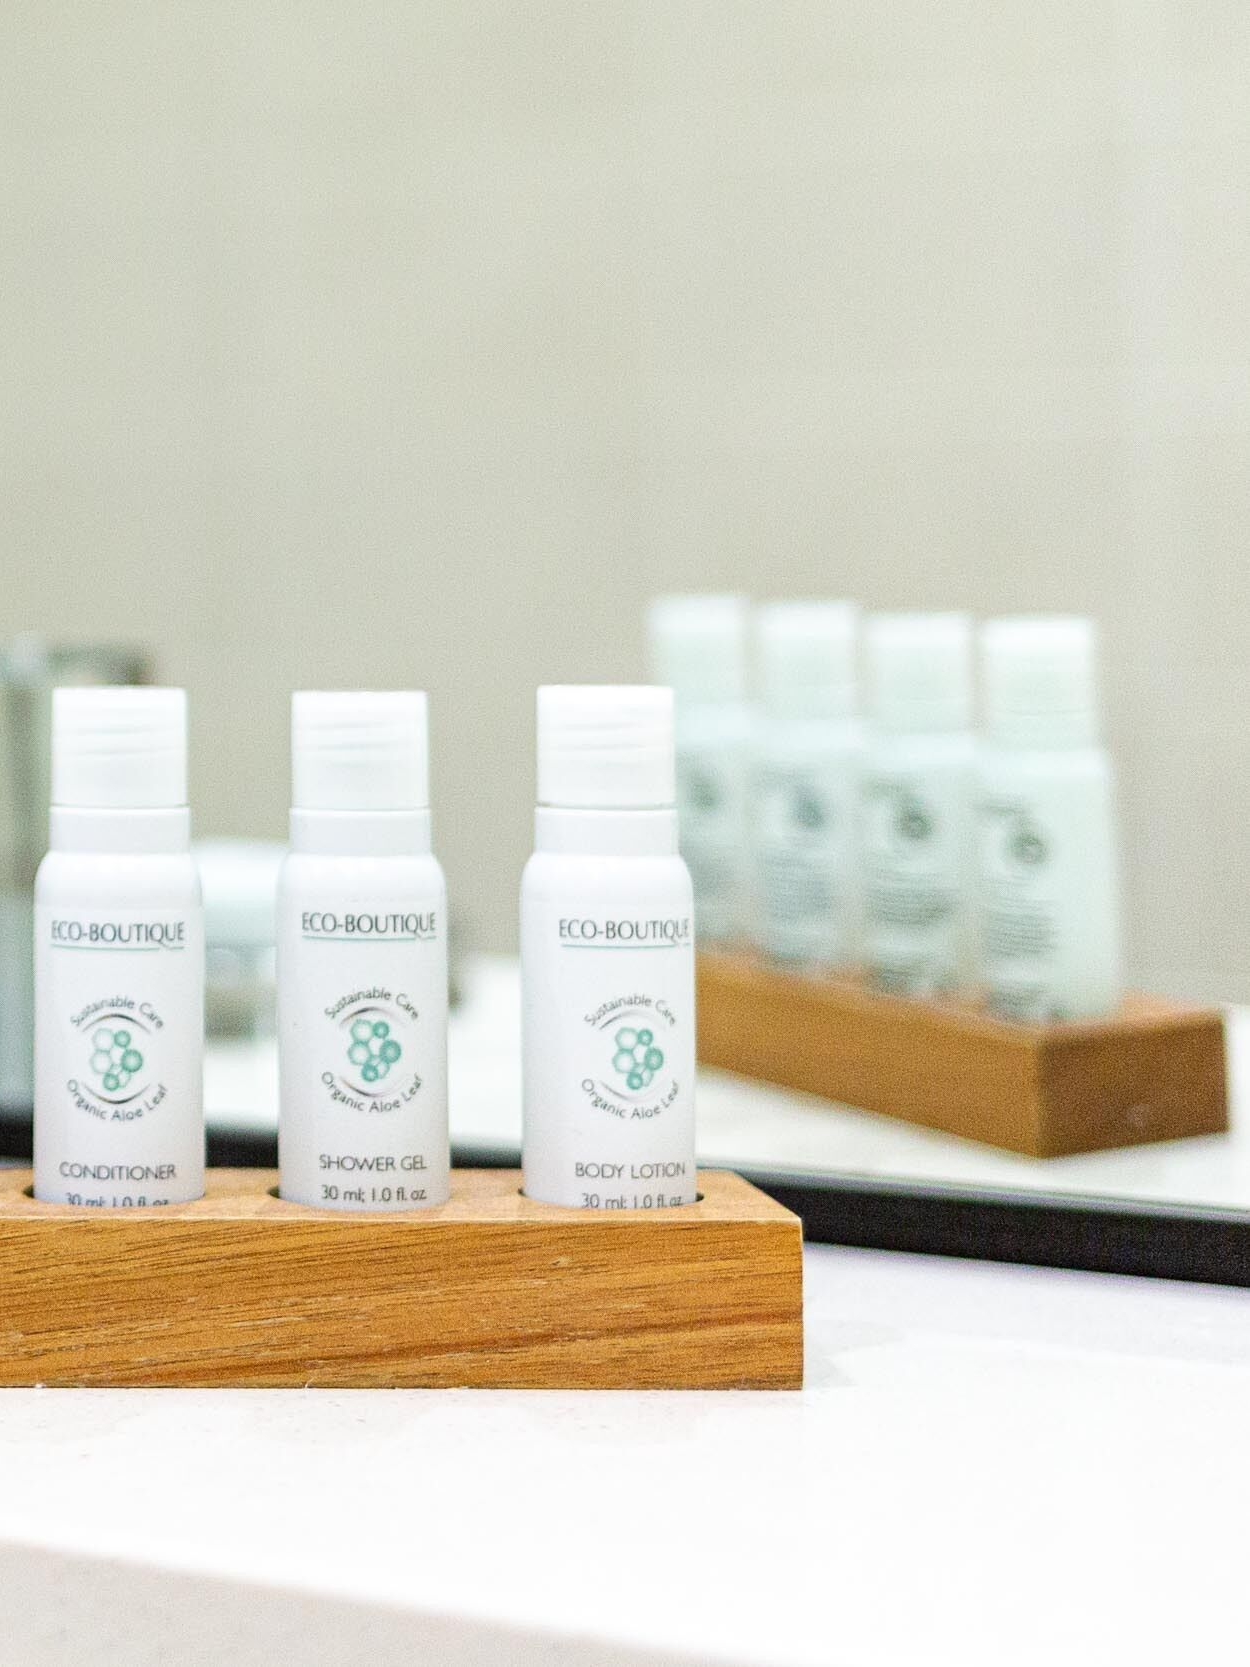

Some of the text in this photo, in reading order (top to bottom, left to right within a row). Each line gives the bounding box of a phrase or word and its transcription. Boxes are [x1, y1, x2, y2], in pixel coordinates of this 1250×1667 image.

[51, 920, 185, 949] ECO-BOUTIQUE
[302, 912, 436, 941] ECO-BOUTIQUE
[559, 918, 690, 946] ECO-BOUTIQUE
[70, 994, 164, 1029] Sustainable Care
[324, 986, 419, 1020] Sustainable Care
[585, 993, 677, 1027] Sustainable Care
[67, 1078, 168, 1122] Organic Aloe Leaf
[321, 1071, 423, 1113] Organic Aloe Leaf
[581, 1078, 681, 1120] Organic Aloe Leaf
[60, 1162, 177, 1180] CONDITIONER
[319, 1154, 428, 1172] SHOWER GEL
[575, 1162, 685, 1179] BODY LOTION
[321, 1184, 339, 1200] 30
[371, 1187, 392, 1202] 1.0
[397, 1187, 408, 1201] fl.
[410, 1189, 427, 1200] oz
[581, 1192, 600, 1208] 30
